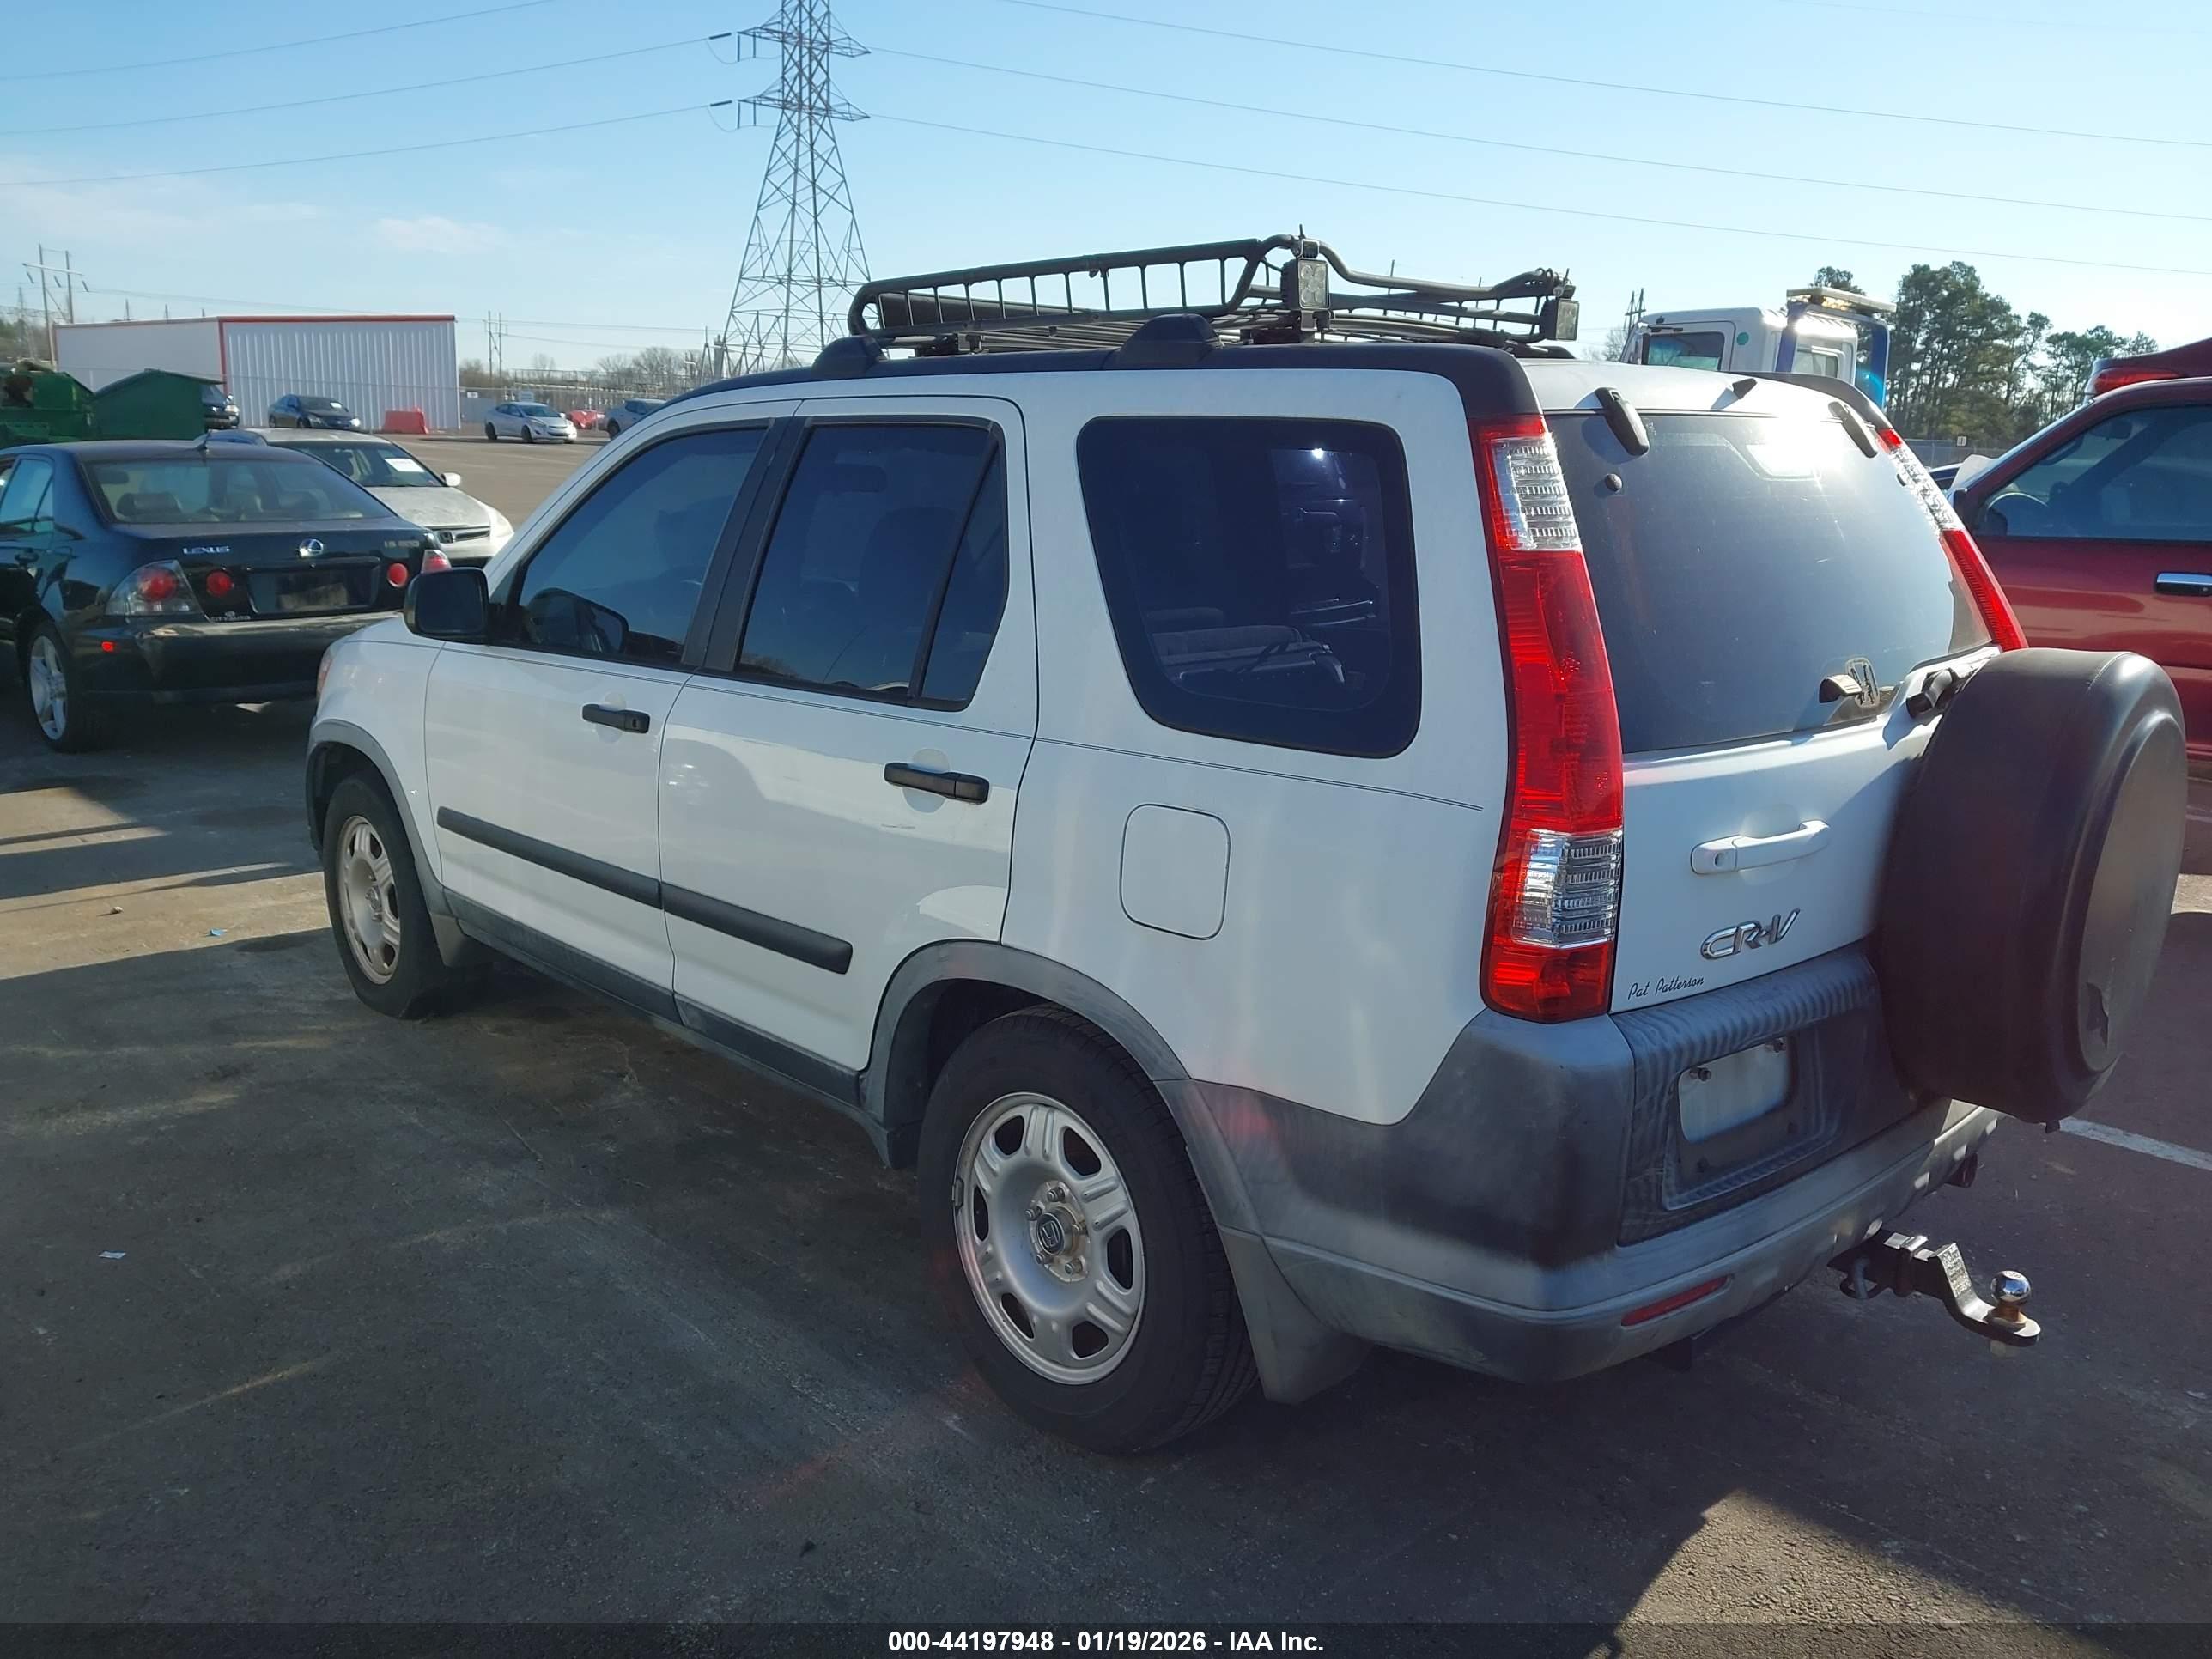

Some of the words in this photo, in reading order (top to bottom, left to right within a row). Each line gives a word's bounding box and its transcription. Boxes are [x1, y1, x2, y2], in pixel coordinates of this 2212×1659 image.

[182, 545, 230, 555] LEXUS
[1699, 908, 1801, 961] CR-V
[1627, 981, 1649, 1000] Pat
[1655, 975, 1705, 996] Patterson
